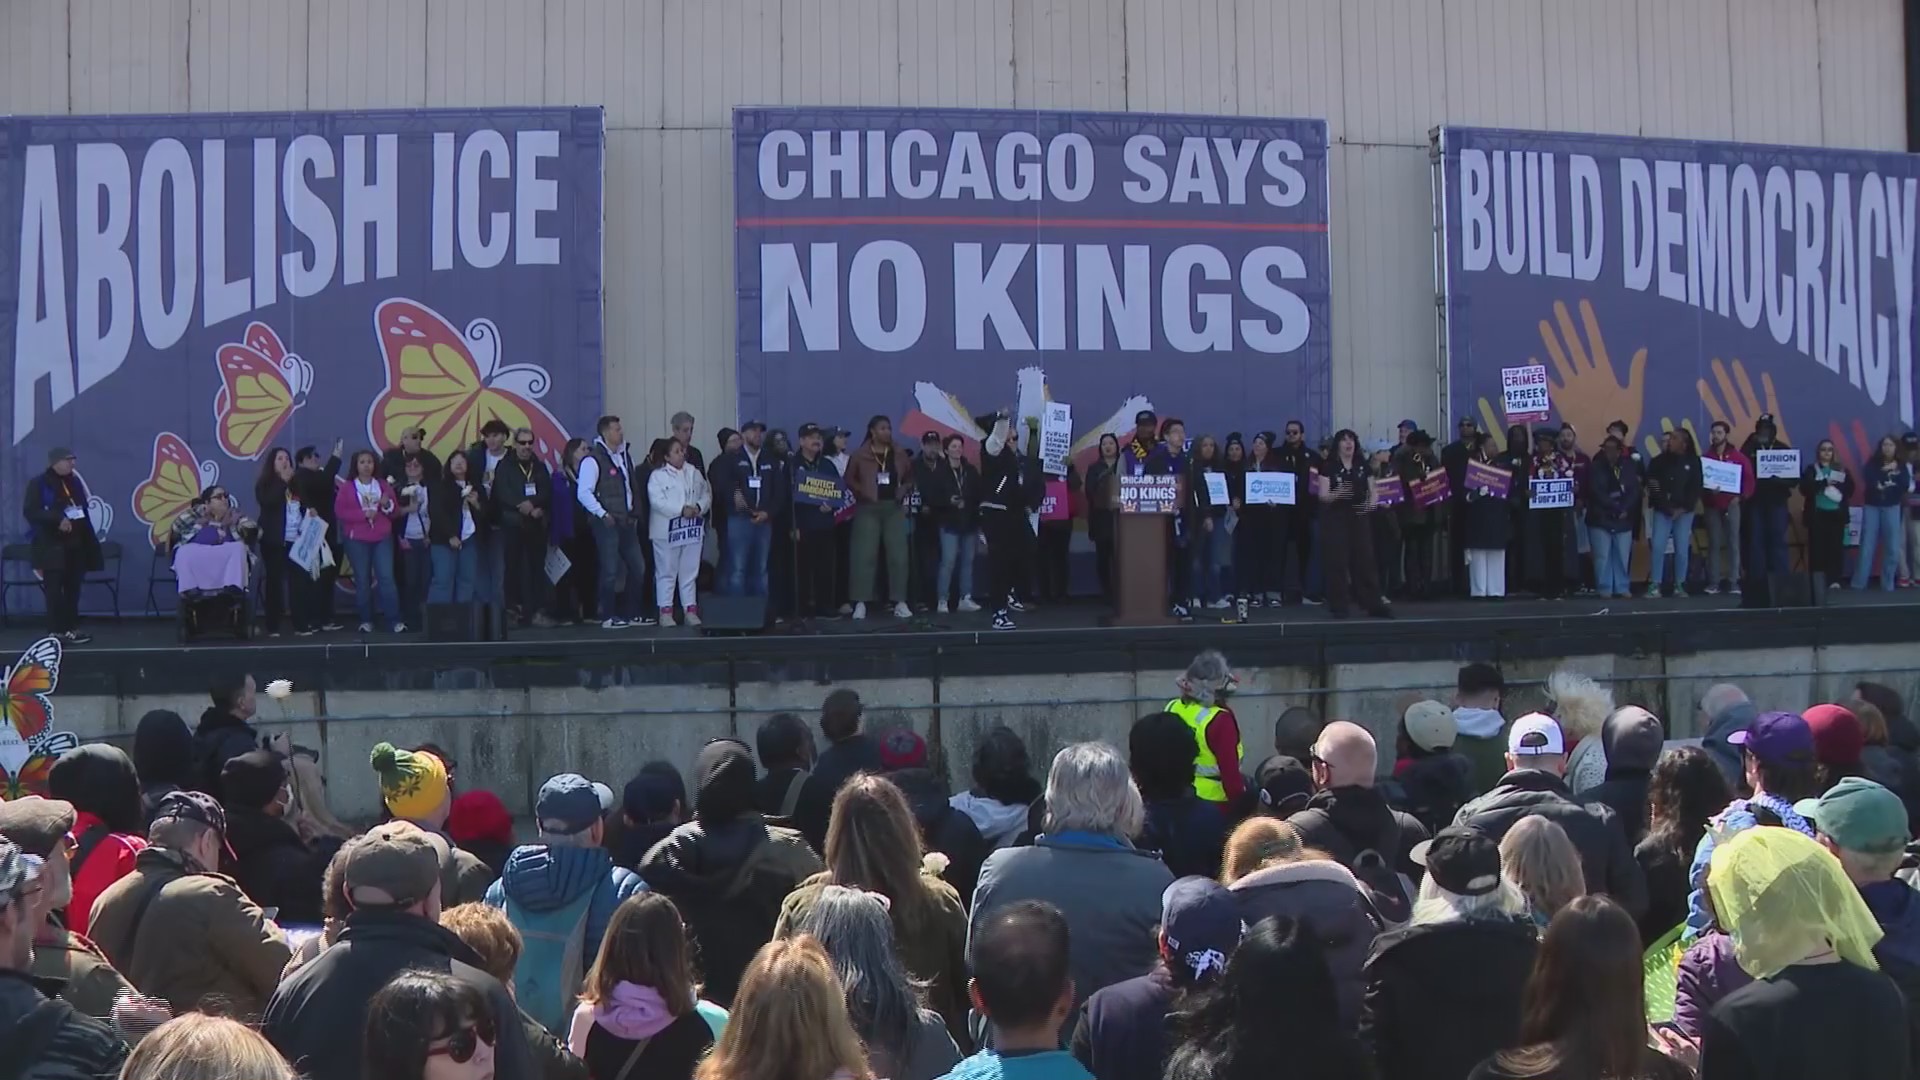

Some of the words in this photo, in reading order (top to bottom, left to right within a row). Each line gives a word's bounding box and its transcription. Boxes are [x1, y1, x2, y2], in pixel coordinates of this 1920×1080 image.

[757, 129, 1096, 203] CHICAGO
[1122, 134, 1307, 208] SAYS
[13, 134, 398, 446] ABOLISH
[432, 129, 560, 270] ICE
[1460, 148, 1604, 282] BUILD
[1619, 157, 1918, 430] DEMOCRACY
[760, 239, 927, 353] NO
[953, 242, 1311, 354] KINGS
[1521, 367, 1543, 375] POLICE
[1504, 373, 1545, 387] CRIMES
[1513, 388, 1540, 400] FREE
[1506, 400, 1529, 409] THEM
[1531, 399, 1547, 408] ALL
[1760, 454, 1797, 463] #UNION
[806, 476, 835, 489] PROTECT
[1120, 475, 1155, 485] CHICAGO
[1156, 475, 1176, 485] SAYS
[798, 483, 842, 499] IMMIGRANTS
[1120, 487, 1138, 500] NO
[1139, 487, 1176, 500] KINGS
[1536, 482, 1549, 493] ICE
